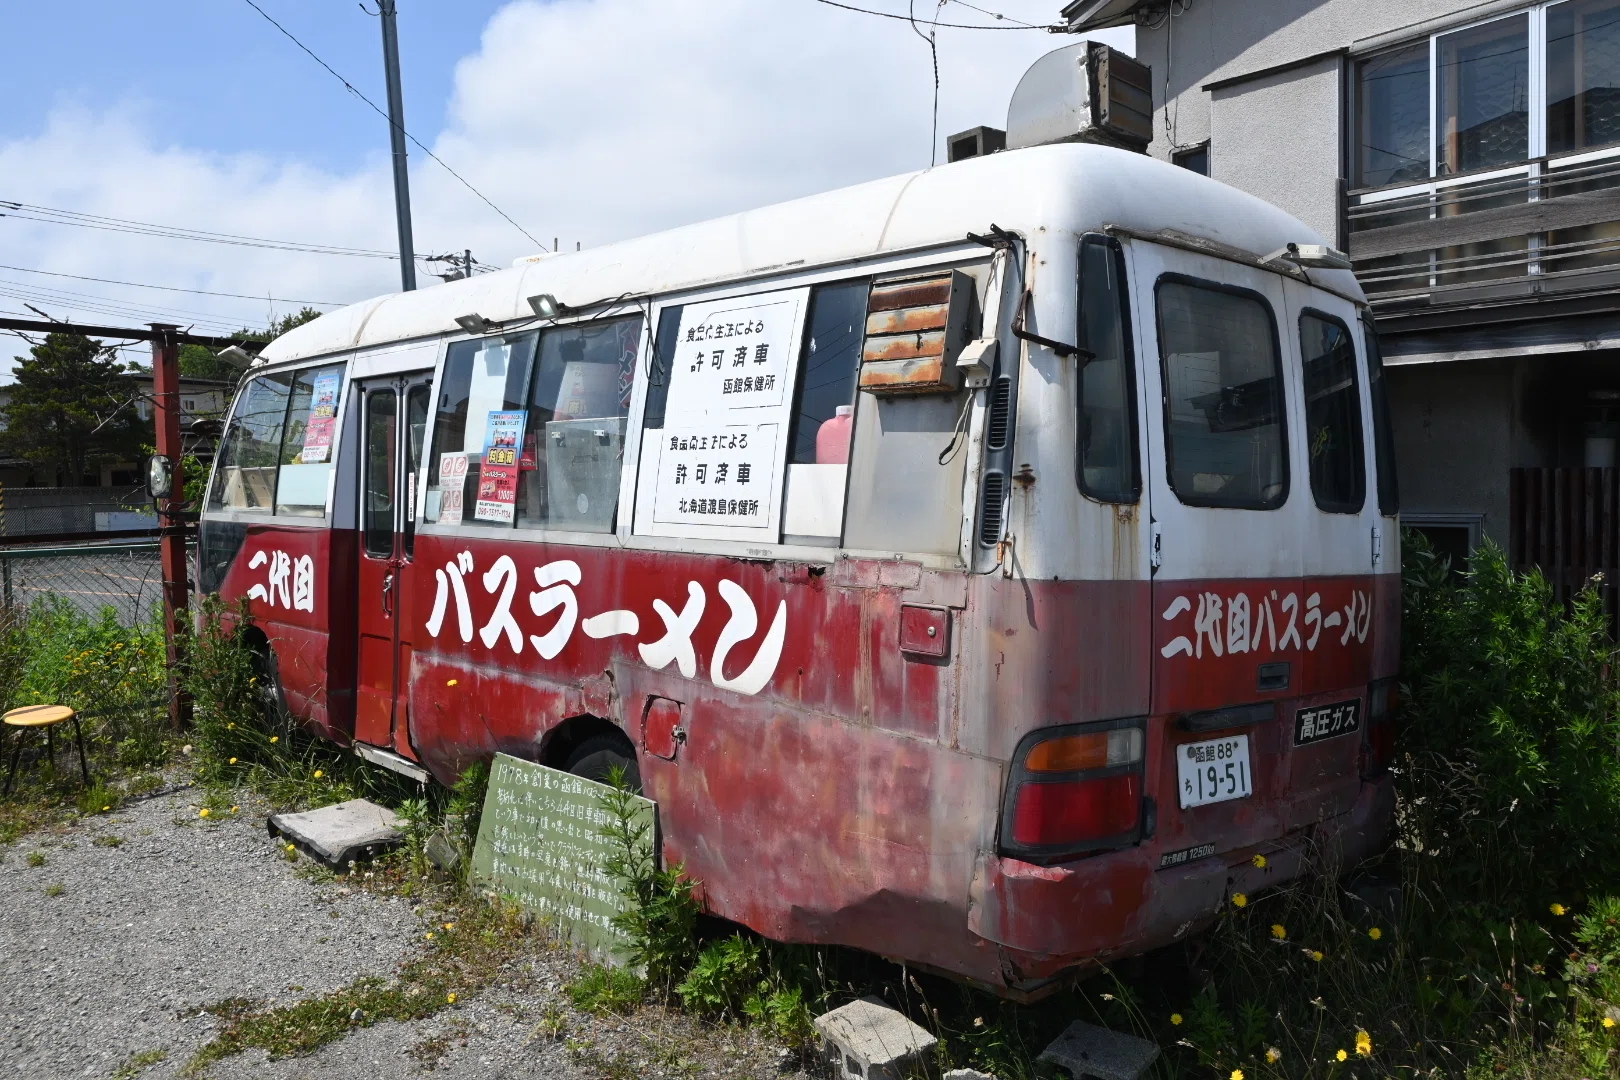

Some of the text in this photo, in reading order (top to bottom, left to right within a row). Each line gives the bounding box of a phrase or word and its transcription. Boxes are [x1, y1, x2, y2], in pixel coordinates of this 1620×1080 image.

[690, 343, 769, 373] 許可済車
[723, 374, 776, 394] 函館保健所
[488, 448, 514, 465] 料金箱
[675, 462, 752, 486] 許可済車
[678, 498, 759, 516] 北海道渡島保健所
[247, 549, 315, 614] 二代目
[425, 549, 788, 696] バスラーメン
[1160, 589, 1372, 660] 二代目バスラーメン
[1300, 704, 1357, 741] 高圧ガス
[1195, 742, 1233, 763] 函館 88
[1184, 760, 1246, 800] ち 19-51
